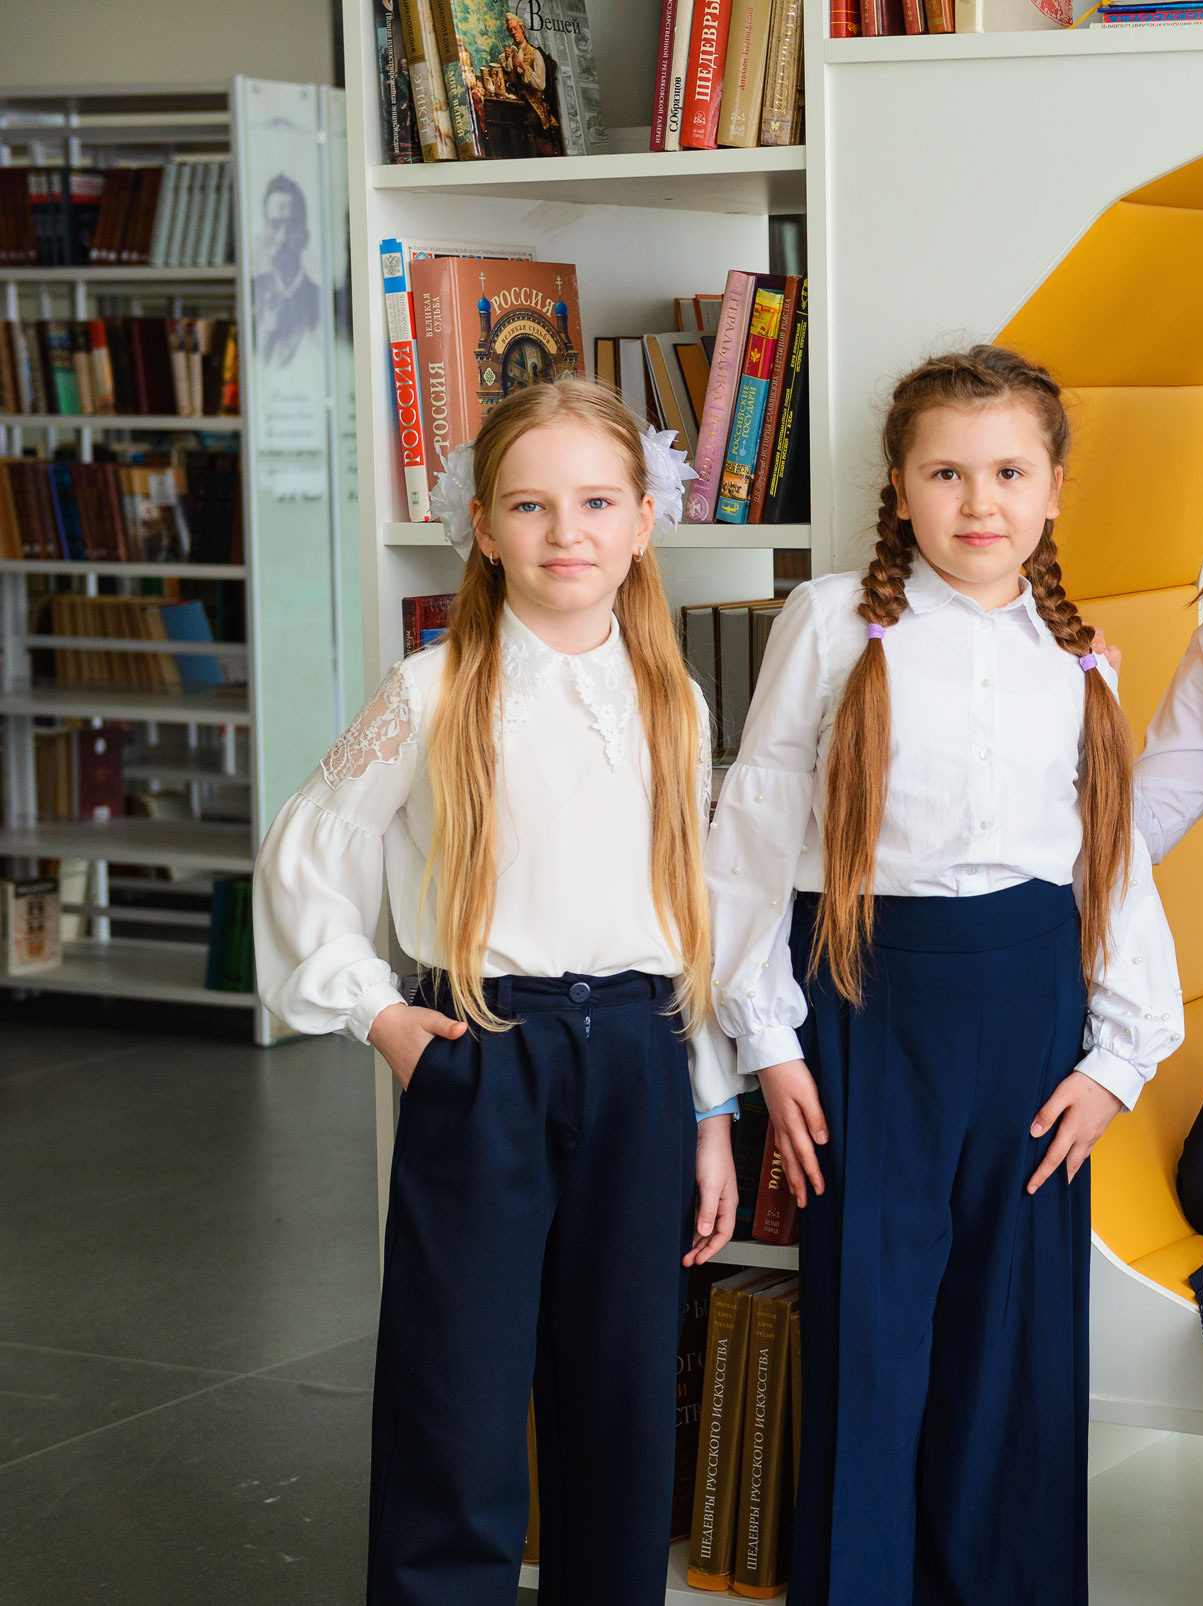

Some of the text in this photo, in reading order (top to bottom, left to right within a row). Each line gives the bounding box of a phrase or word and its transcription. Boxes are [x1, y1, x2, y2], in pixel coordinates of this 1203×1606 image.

[527, 0, 582, 35] Вещей
[695, 0, 721, 102] ШЕДЕВРЫ
[738, 58, 748, 91] Аполлон
[414, 73, 430, 134] ЭТИКЕТ
[448, 71, 464, 138] МИР ВЕЩЕЙ
[658, 60, 668, 114] ТРЕТЬЯКОВСКОЙ
[655, 116, 664, 144] ГАЛЕРЕИ
[423, 292, 434, 338] ВЕЛИКАЯ
[434, 296, 442, 333] СУДЬБА
[491, 286, 555, 318] РОССИЯ
[782, 298, 792, 330] РОДСТВА
[502, 324, 550, 345] великая судьба
[774, 332, 786, 372] ТЕРМИНОВ
[392, 345, 422, 466] РОССИЯ
[428, 360, 450, 448] РОССИЯ
[699, 298, 739, 482] ГЕРАЛЬДИКА РОССИИ
[742, 386, 757, 438] ГОСУДАРИ
[766, 376, 780, 422] СЛАВЯНСКИХ
[731, 385, 750, 455] РОССИЙСКИЕ
[761, 424, 772, 458] ИСТОРИЯ
[700, 1338, 728, 1558] ШЕДЕВРЫ РУССКОГО ИСКУССТВА
[747, 1348, 769, 1570] ШЕДЕВРЫ РУССКОГО ИСКУССТВА
